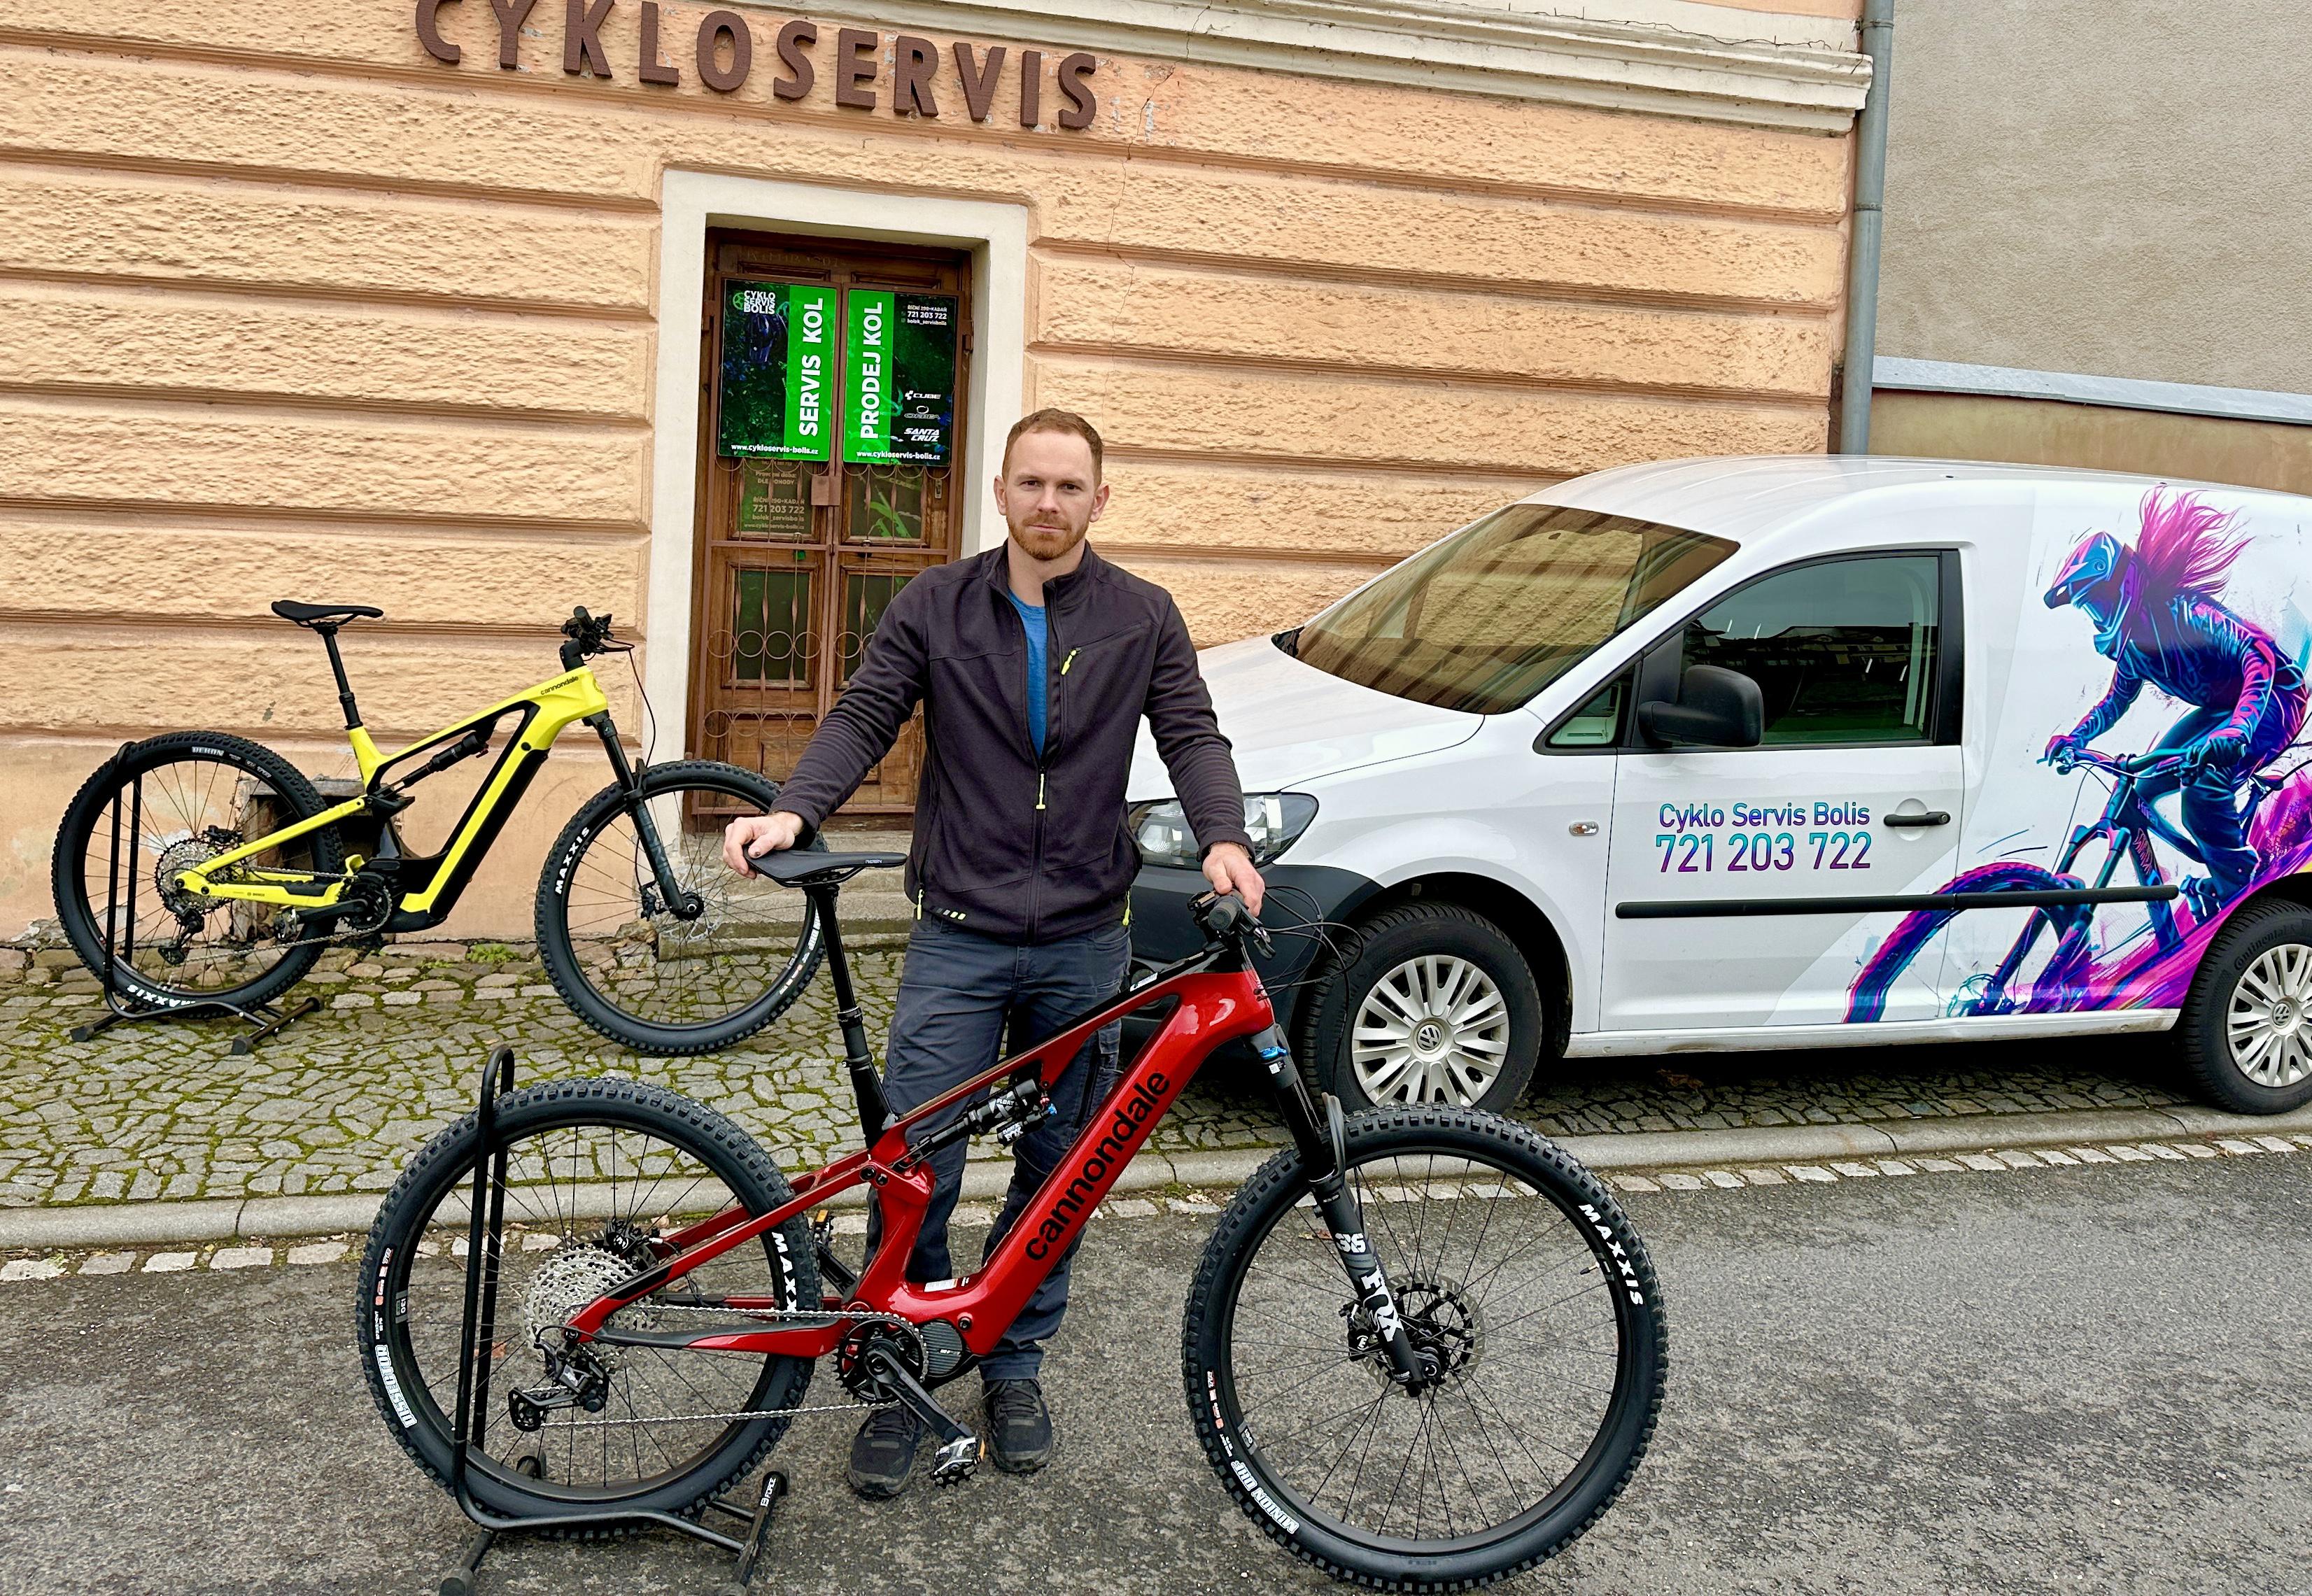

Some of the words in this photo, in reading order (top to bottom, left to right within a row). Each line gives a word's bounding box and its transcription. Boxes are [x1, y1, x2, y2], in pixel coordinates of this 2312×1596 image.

[415, 0, 1097, 130] CYKLOSERVIS
[744, 290, 776, 299] CYKLO
[744, 297, 776, 308] SERVIS
[744, 304, 776, 315] BOLIS
[803, 298, 824, 344] KOL
[863, 302, 882, 346] KOL
[798, 354, 822, 437] SERVIS
[860, 351, 881, 439] PRODEJ
[731, 444, 819, 455] www.cykloservis-bolis.cz
[903, 428, 940, 436] SANTA
[857, 451, 940, 460] www.cykloservis-bolis.cz
[770, 505, 786, 514] 203
[789, 506, 805, 514] 722
[540, 676, 579, 695] cannondale
[1659, 803, 1724, 833] Cyklo
[1732, 802, 1806, 827] Servis
[1813, 802, 1870, 826] Bolis
[555, 827, 589, 894] MAXXIS
[1656, 833, 1713, 873] 721
[1727, 833, 1794, 871] 203
[1809, 832, 1872, 870] 722
[1024, 1072, 1171, 1261] cannondale
[1335, 1233, 1366, 1253] 36
[1578, 1203, 1644, 1305] MAXXIS
[771, 1231, 798, 1315] MAXX
[1361, 1264, 1404, 1343] FOX
[374, 1344, 418, 1429] DISSECTOR
[1230, 1460, 1257, 1492] DHF
[1250, 1487, 1300, 1534] MINION
